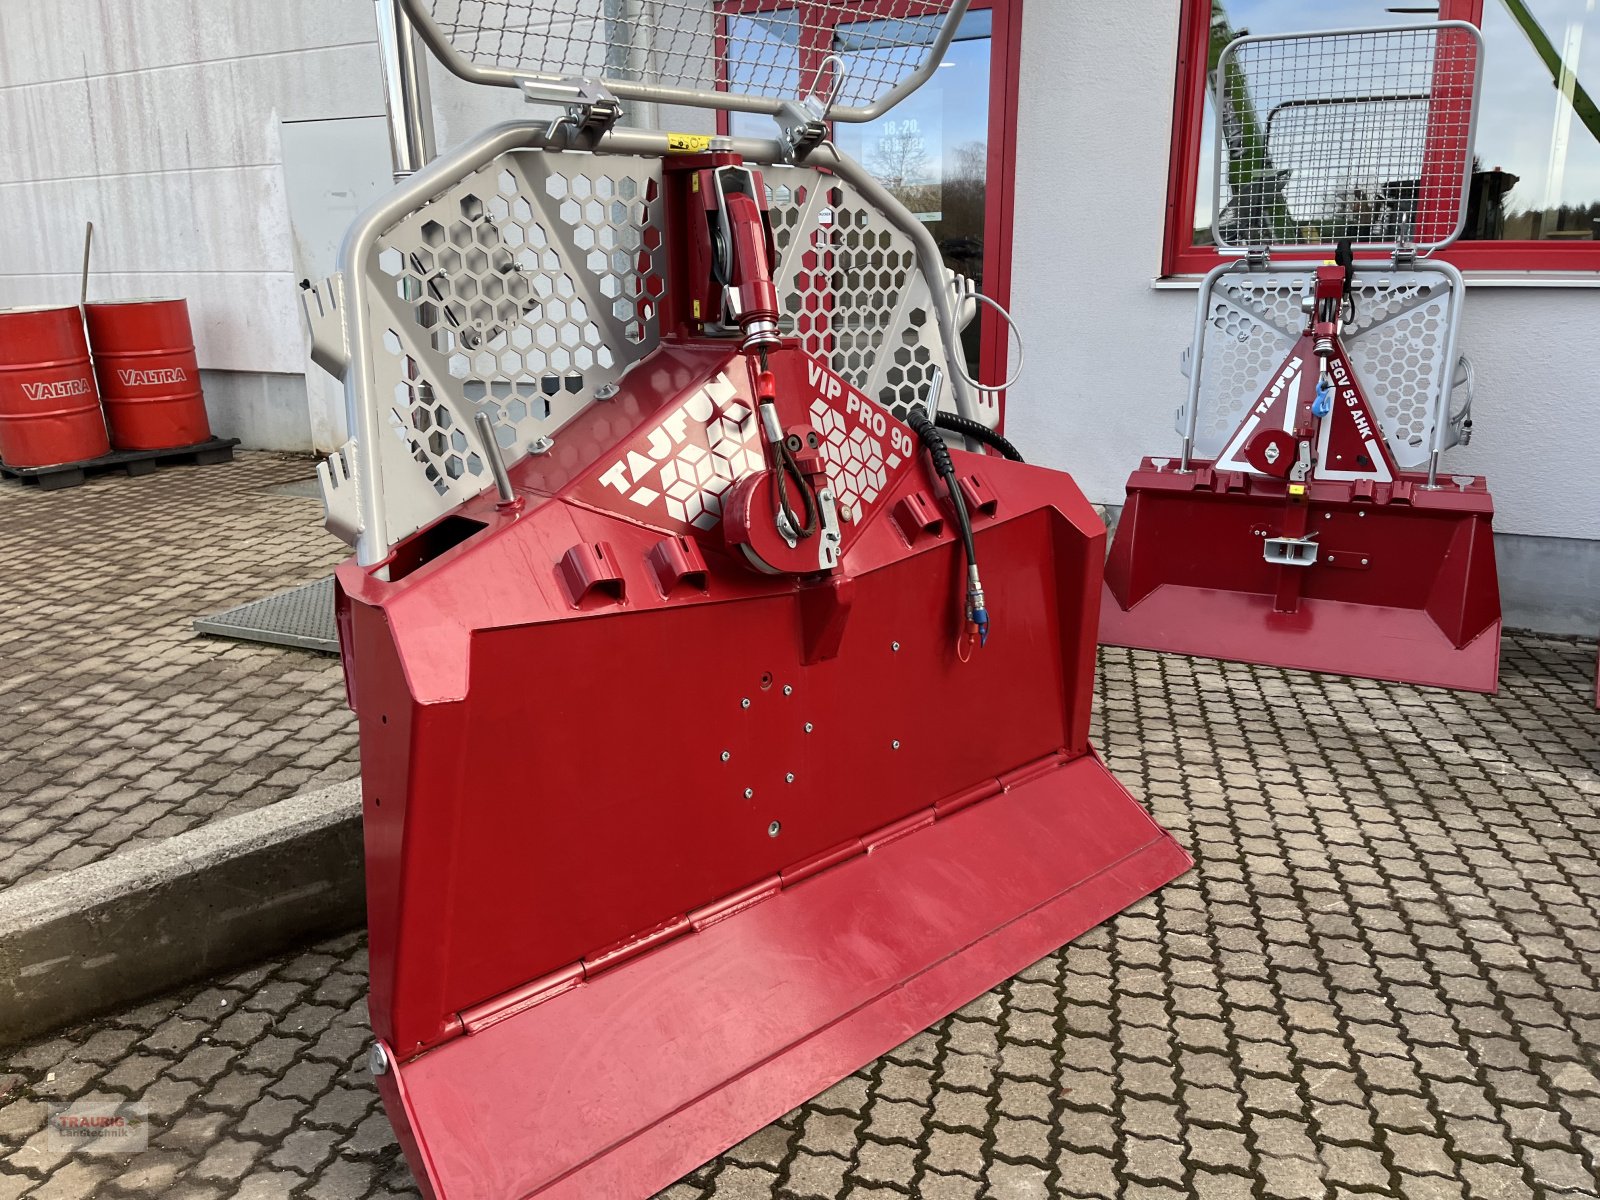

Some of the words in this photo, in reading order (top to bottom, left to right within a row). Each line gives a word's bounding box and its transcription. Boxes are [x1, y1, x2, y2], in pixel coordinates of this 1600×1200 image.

[117, 368, 187, 386] VALTRA
[1255, 356, 1303, 414] TAJFUN
[1329, 358, 1350, 387] EGV
[21, 378, 91, 401] VALTRA
[1343, 389, 1358, 407] 55
[807, 359, 842, 400] VIP
[846, 390, 887, 438] PRO
[891, 427, 913, 458] 90
[598, 371, 738, 495] TAJFUN
[1350, 409, 1373, 440] AHK
